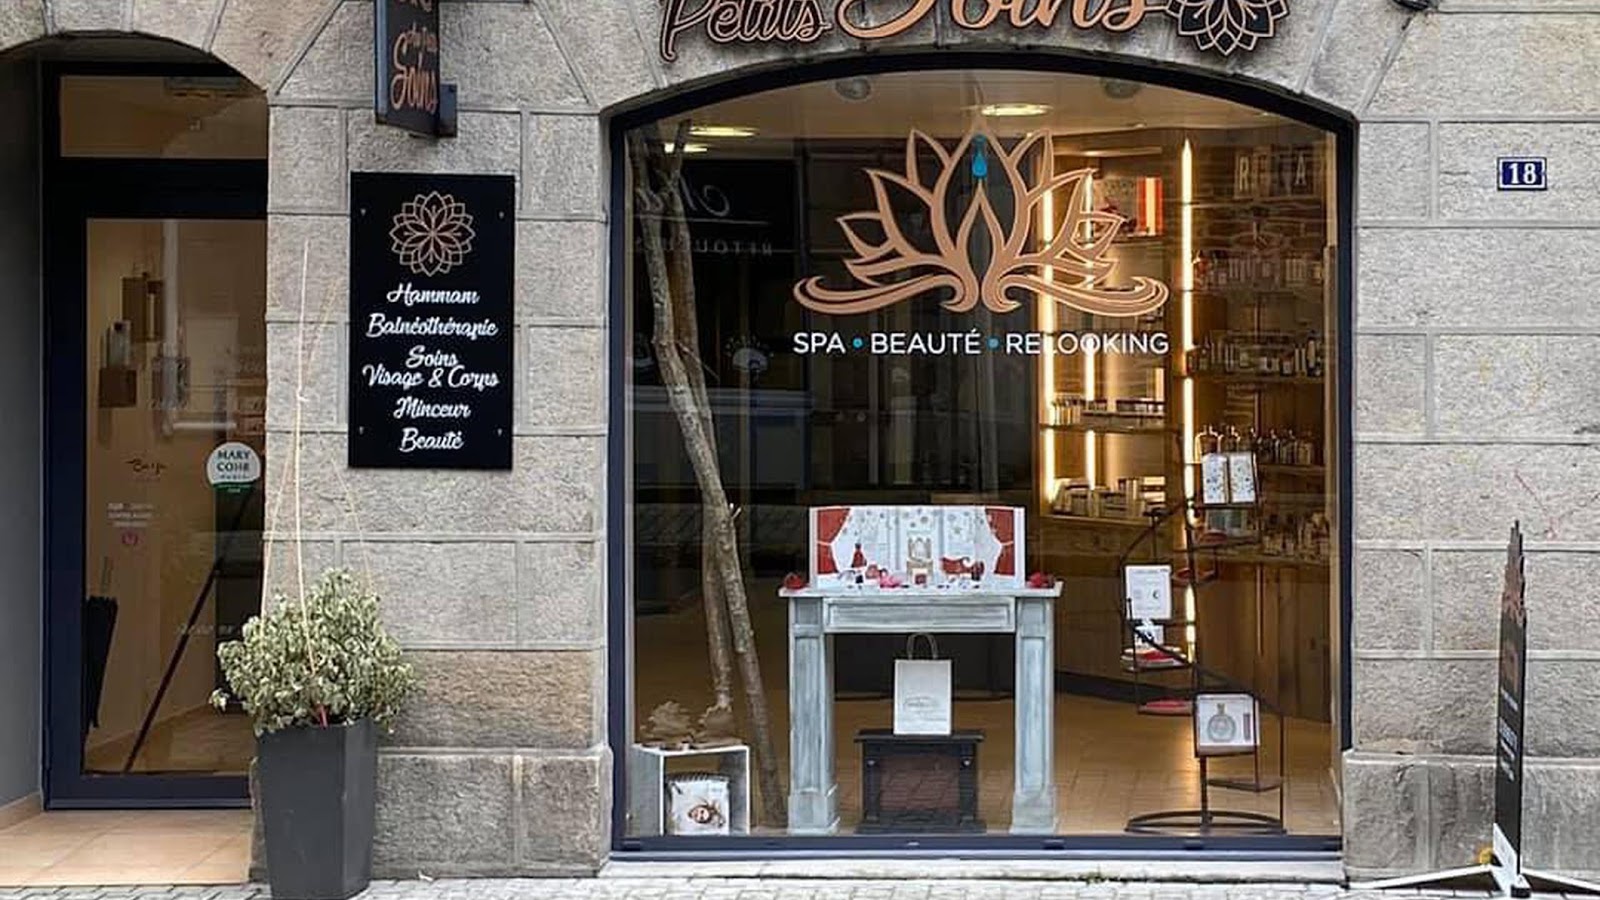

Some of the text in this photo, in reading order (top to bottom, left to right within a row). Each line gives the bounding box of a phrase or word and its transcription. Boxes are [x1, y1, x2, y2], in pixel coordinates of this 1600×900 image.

[1508, 162, 1537, 184] 18
[386, 282, 480, 307] Hammam
[365, 312, 499, 341] Balnéothérapie
[793, 328, 1170, 355] SPA BEAUTÉ RELOOKING
[405, 344, 458, 368] Soins
[362, 363, 499, 392] Visage & Corps
[393, 395, 472, 419] Minceur
[399, 427, 464, 453] Beauté
[217, 449, 250, 461] MARY
